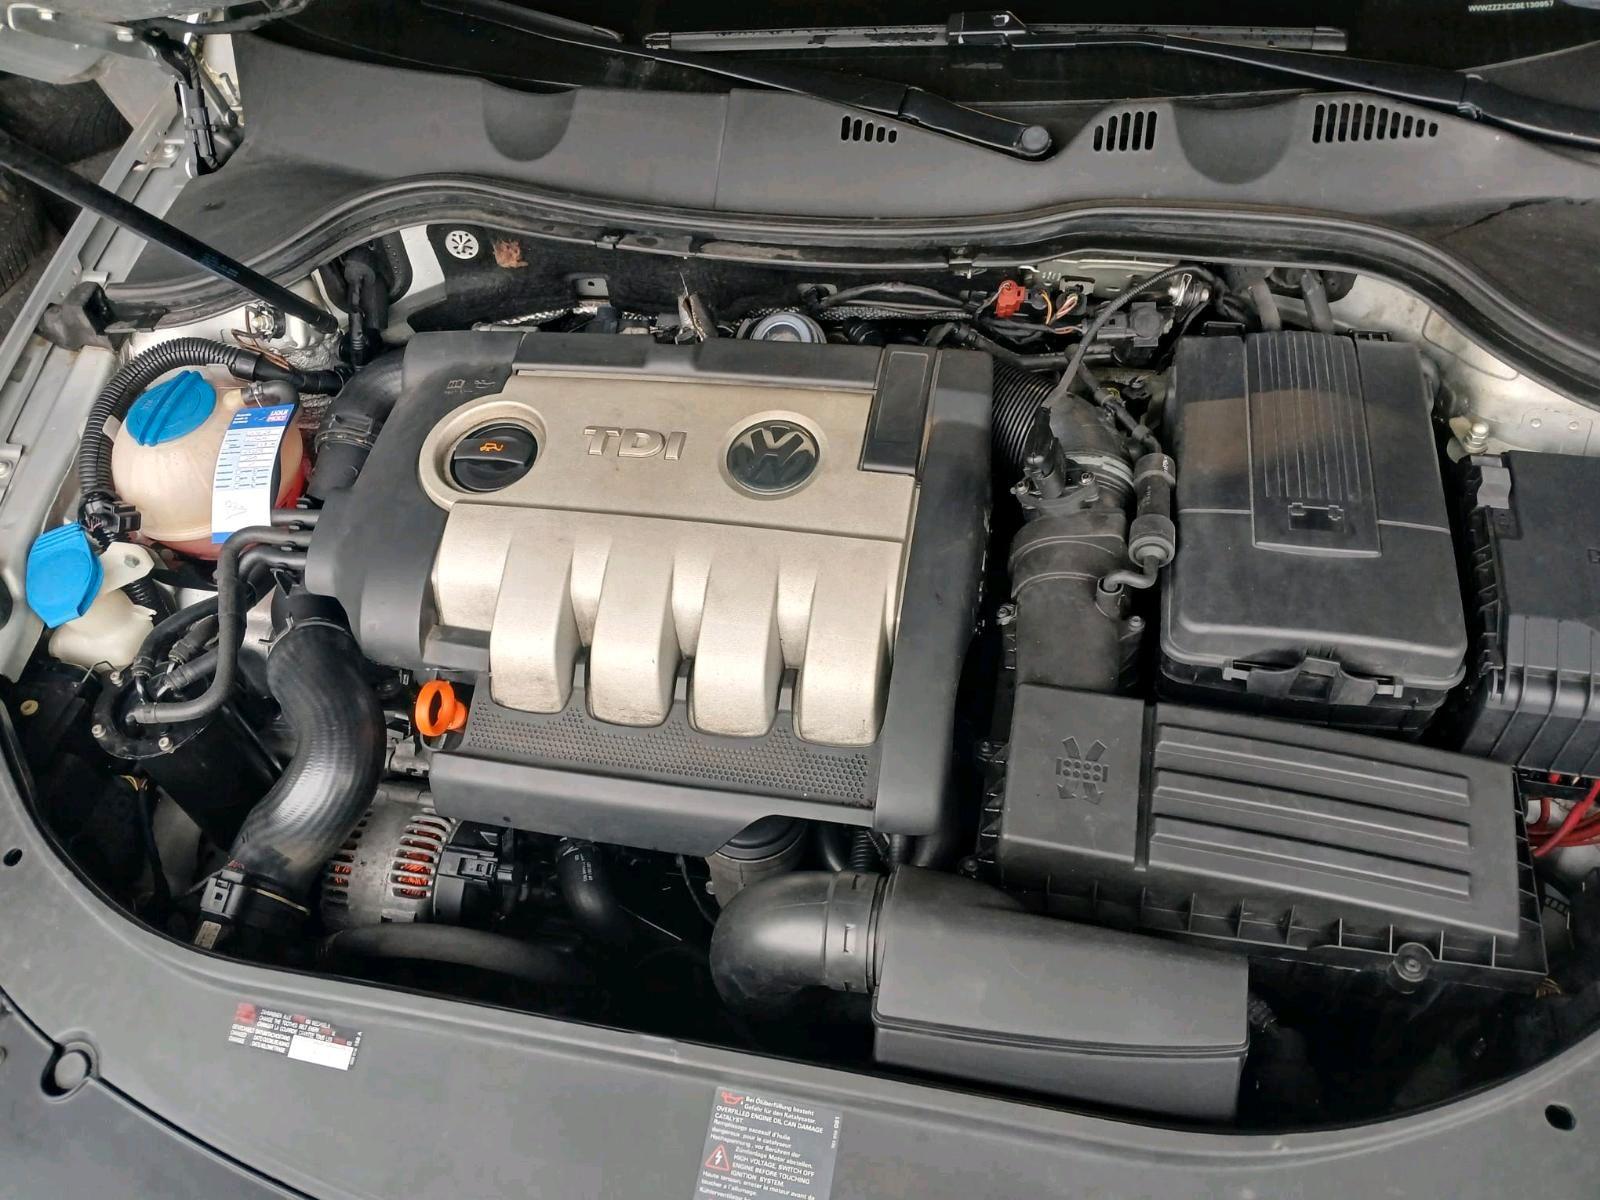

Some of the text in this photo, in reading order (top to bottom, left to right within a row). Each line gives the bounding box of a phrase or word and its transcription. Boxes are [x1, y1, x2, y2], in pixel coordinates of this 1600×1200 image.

[584, 426, 688, 461] TDI
[716, 1105, 824, 1134] OVERFILLED ENGINE OIL CAN DAMAGE
[754, 1166, 778, 1178] BEFORE
[778, 1164, 802, 1175] SWITCH
[802, 1169, 815, 1177] OFF
